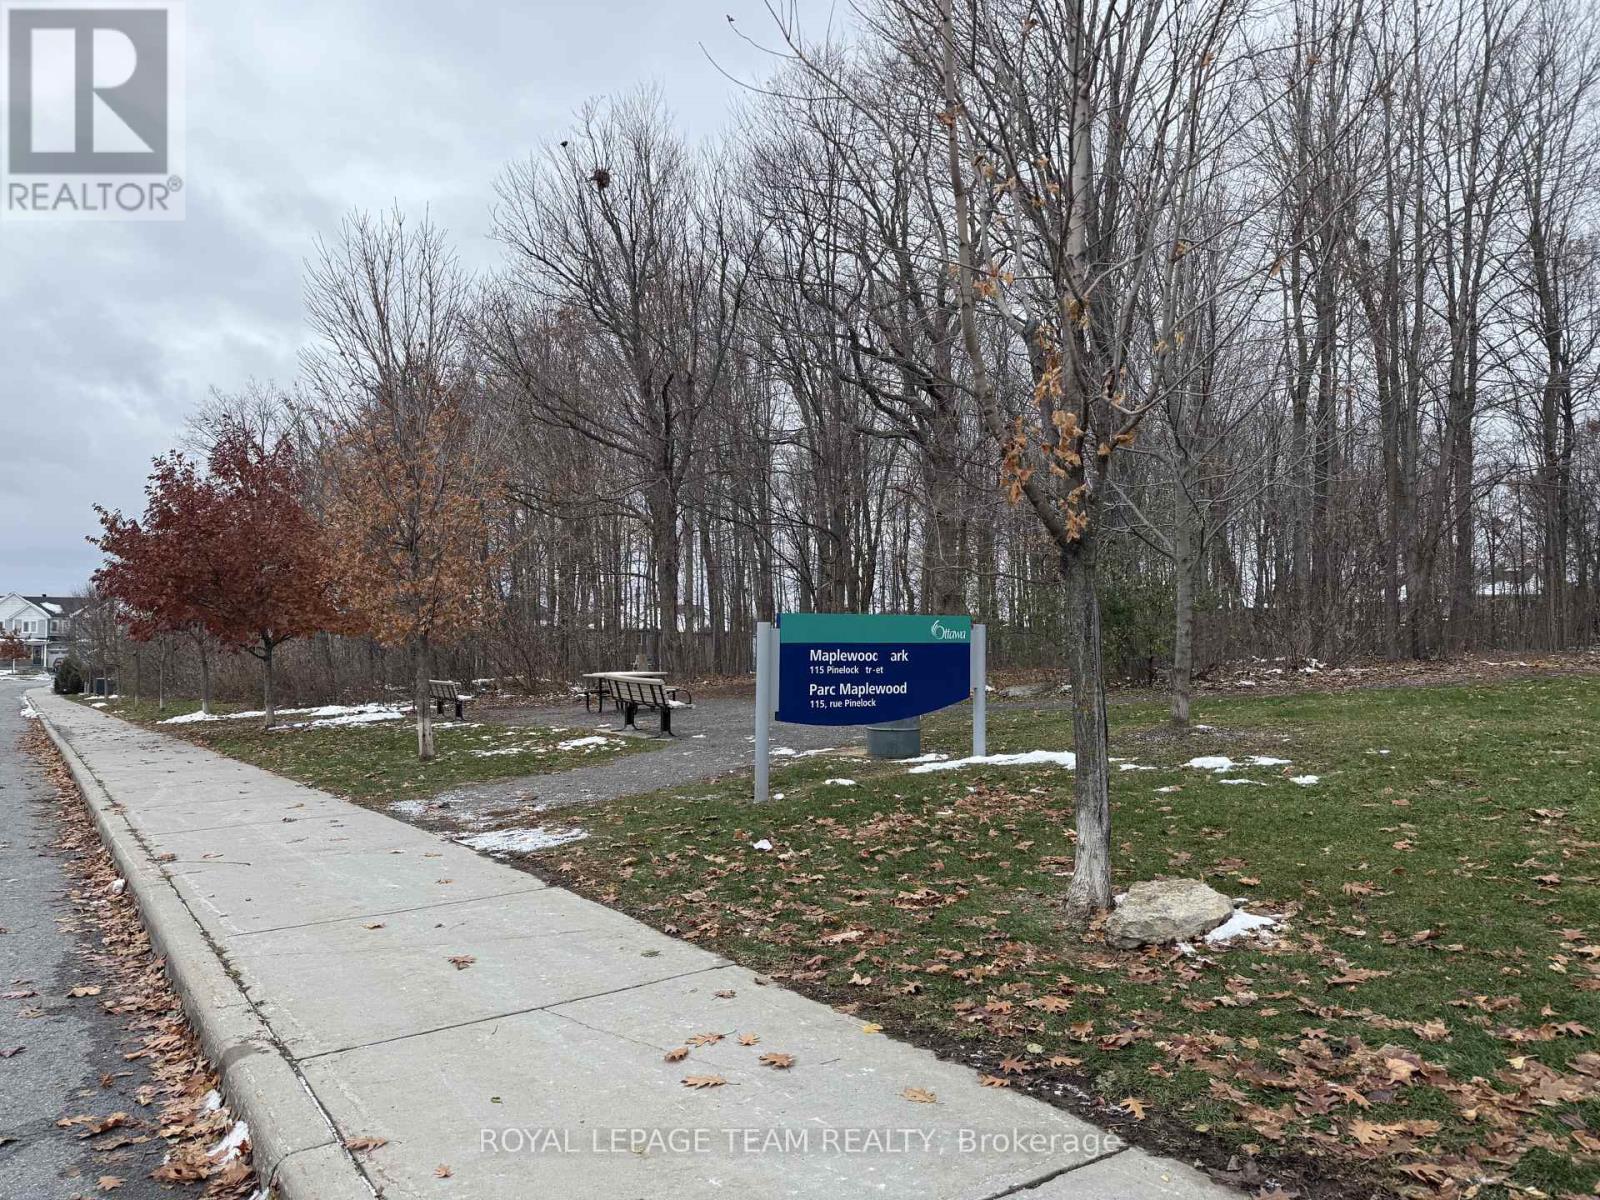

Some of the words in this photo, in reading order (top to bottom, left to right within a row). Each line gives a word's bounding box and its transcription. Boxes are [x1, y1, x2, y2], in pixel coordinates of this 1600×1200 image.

[931, 620, 966, 640] Ottawa
[890, 649, 909, 662] ark
[810, 666, 825, 674] 115
[827, 666, 860, 674] Pinelock
[865, 666, 884, 674] tret
[809, 684, 836, 696] Parc
[839, 682, 908, 698] Maplewood
[810, 700, 827, 709] 115,
[844, 698, 876, 707] Pinelock
